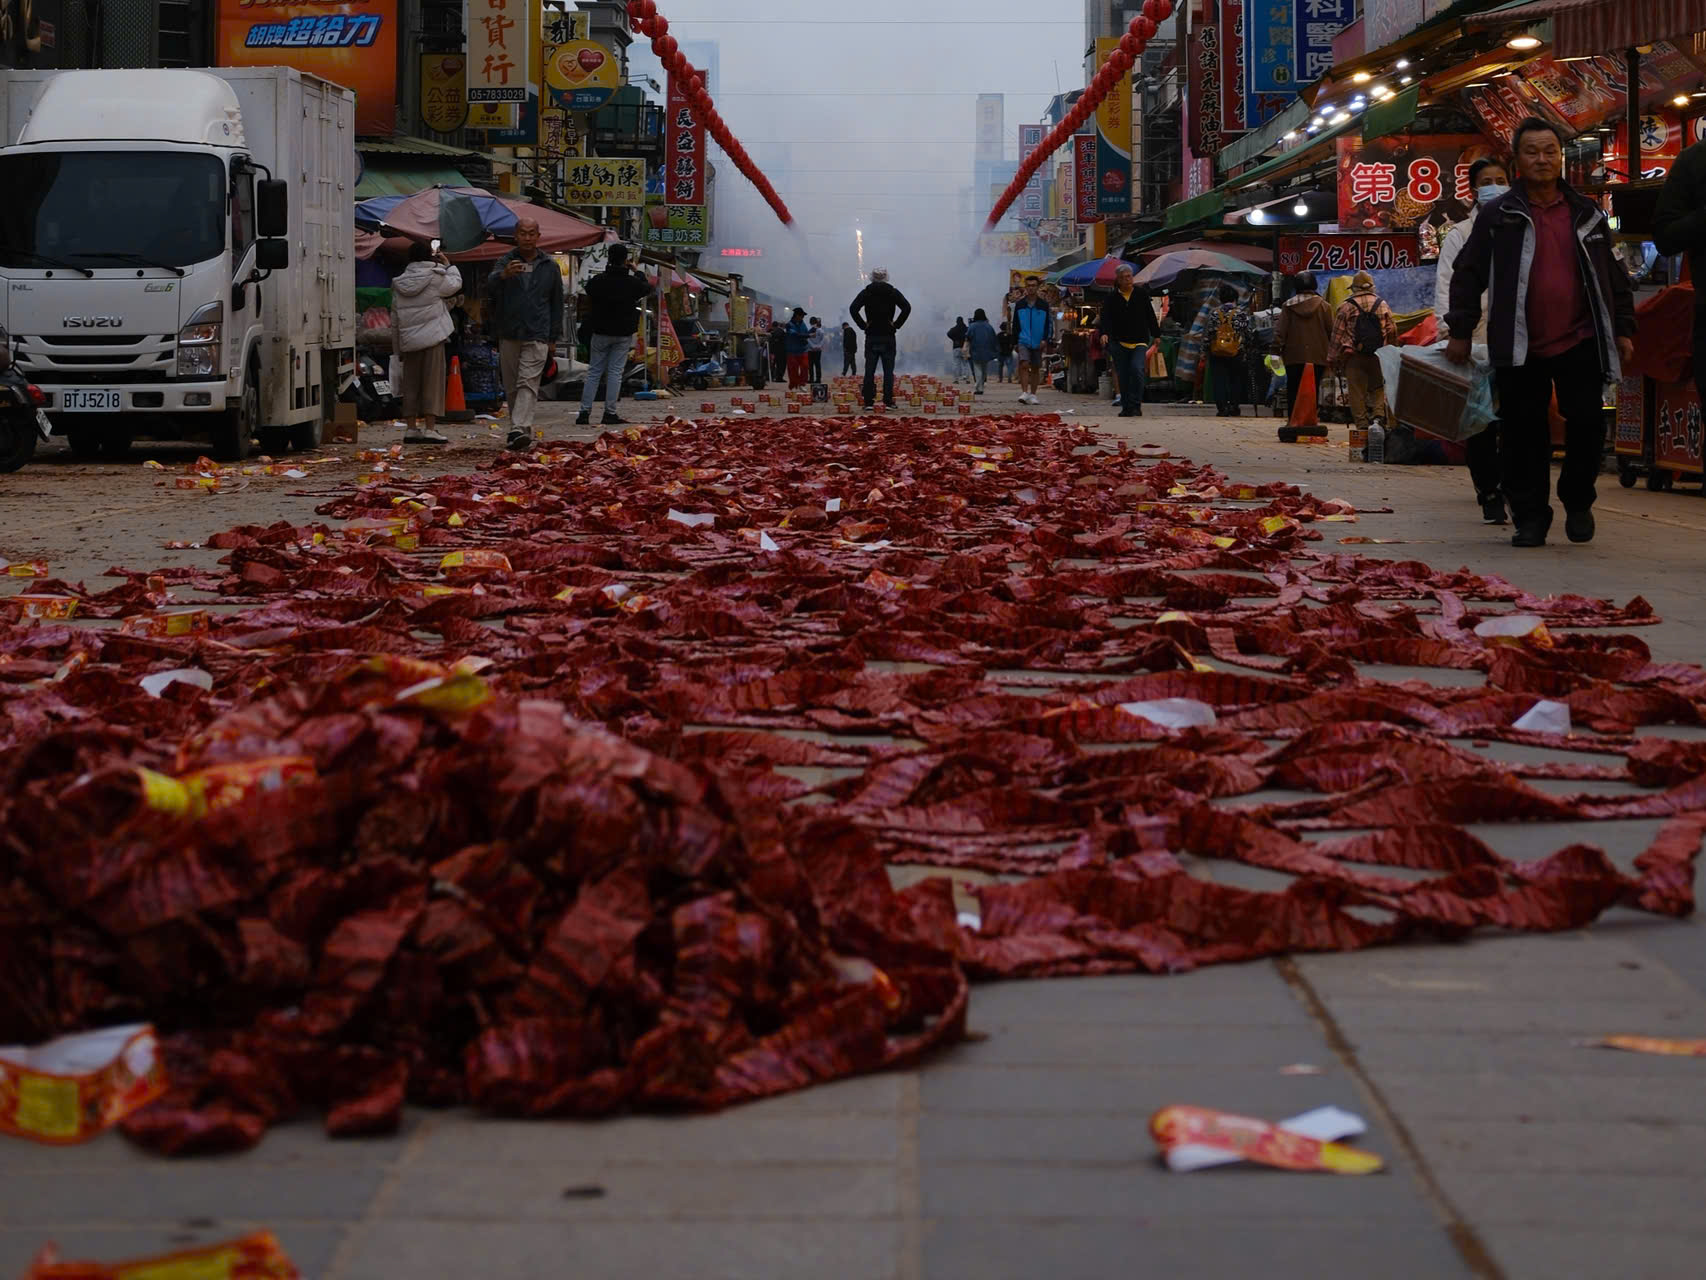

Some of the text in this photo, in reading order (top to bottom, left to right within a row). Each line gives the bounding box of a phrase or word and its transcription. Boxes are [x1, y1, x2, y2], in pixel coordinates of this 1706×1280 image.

[245, 15, 381, 47] 胡牌超給力
[471, 89, 524, 100] 05-7833029
[647, 228, 702, 242] 泰國奶茶
[1306, 240, 1414, 270] 2包150元
[63, 316, 123, 328] ISUZU
[64, 393, 120, 408] BTJ-5218
